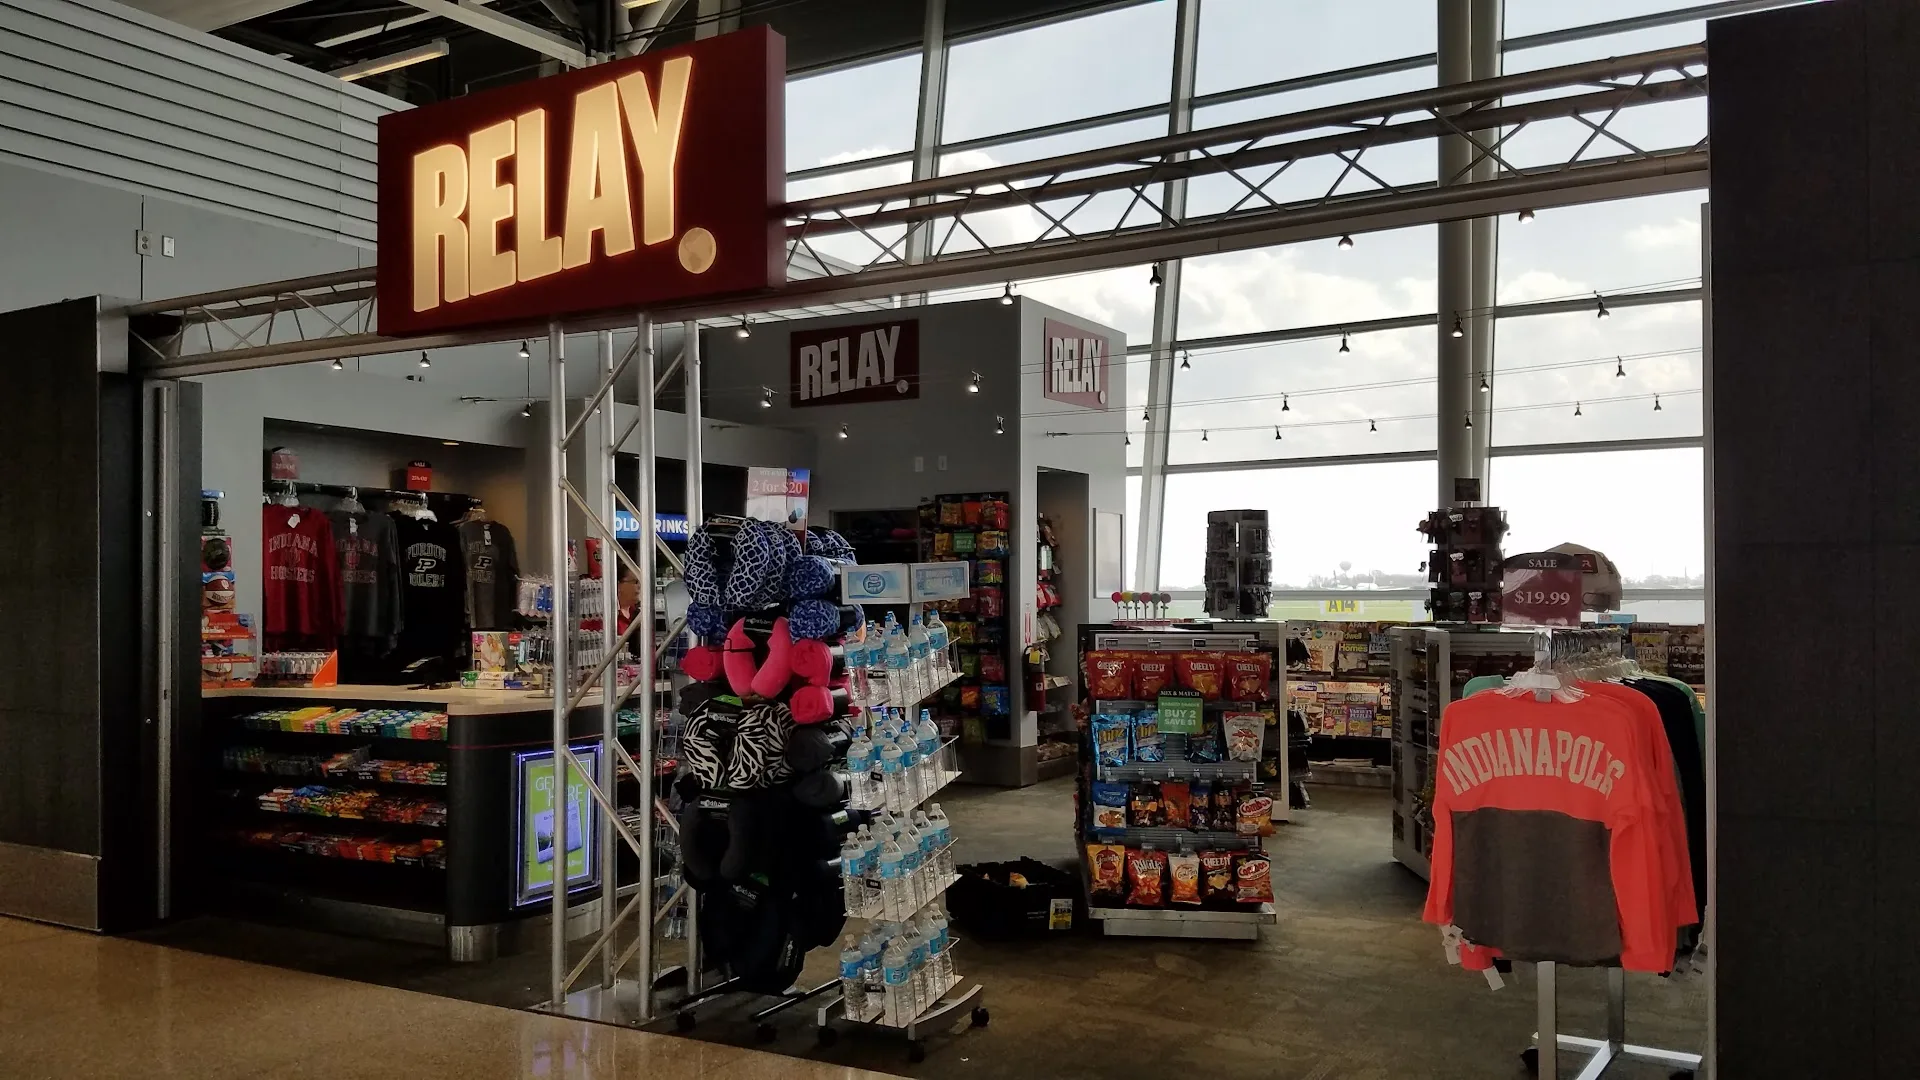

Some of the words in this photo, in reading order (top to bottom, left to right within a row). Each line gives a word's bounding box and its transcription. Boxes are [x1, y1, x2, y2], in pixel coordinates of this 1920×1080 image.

[752, 480, 760, 492] 2
[762, 480, 779, 492] for
[781, 481, 803, 494] $20
[616, 518, 639, 531] OLD
[656, 520, 689, 534] RINKS
[268, 532, 319, 558] INDIANA
[1528, 559, 1558, 568] SALE
[1514, 590, 1571, 606] $19.99
[1339, 643, 1368, 652] Homes
[1164, 708, 1187, 718] BUY
[1189, 709, 1197, 719] 2
[1164, 718, 1186, 726] SAVE
[1240, 798, 1271, 813] Combos
